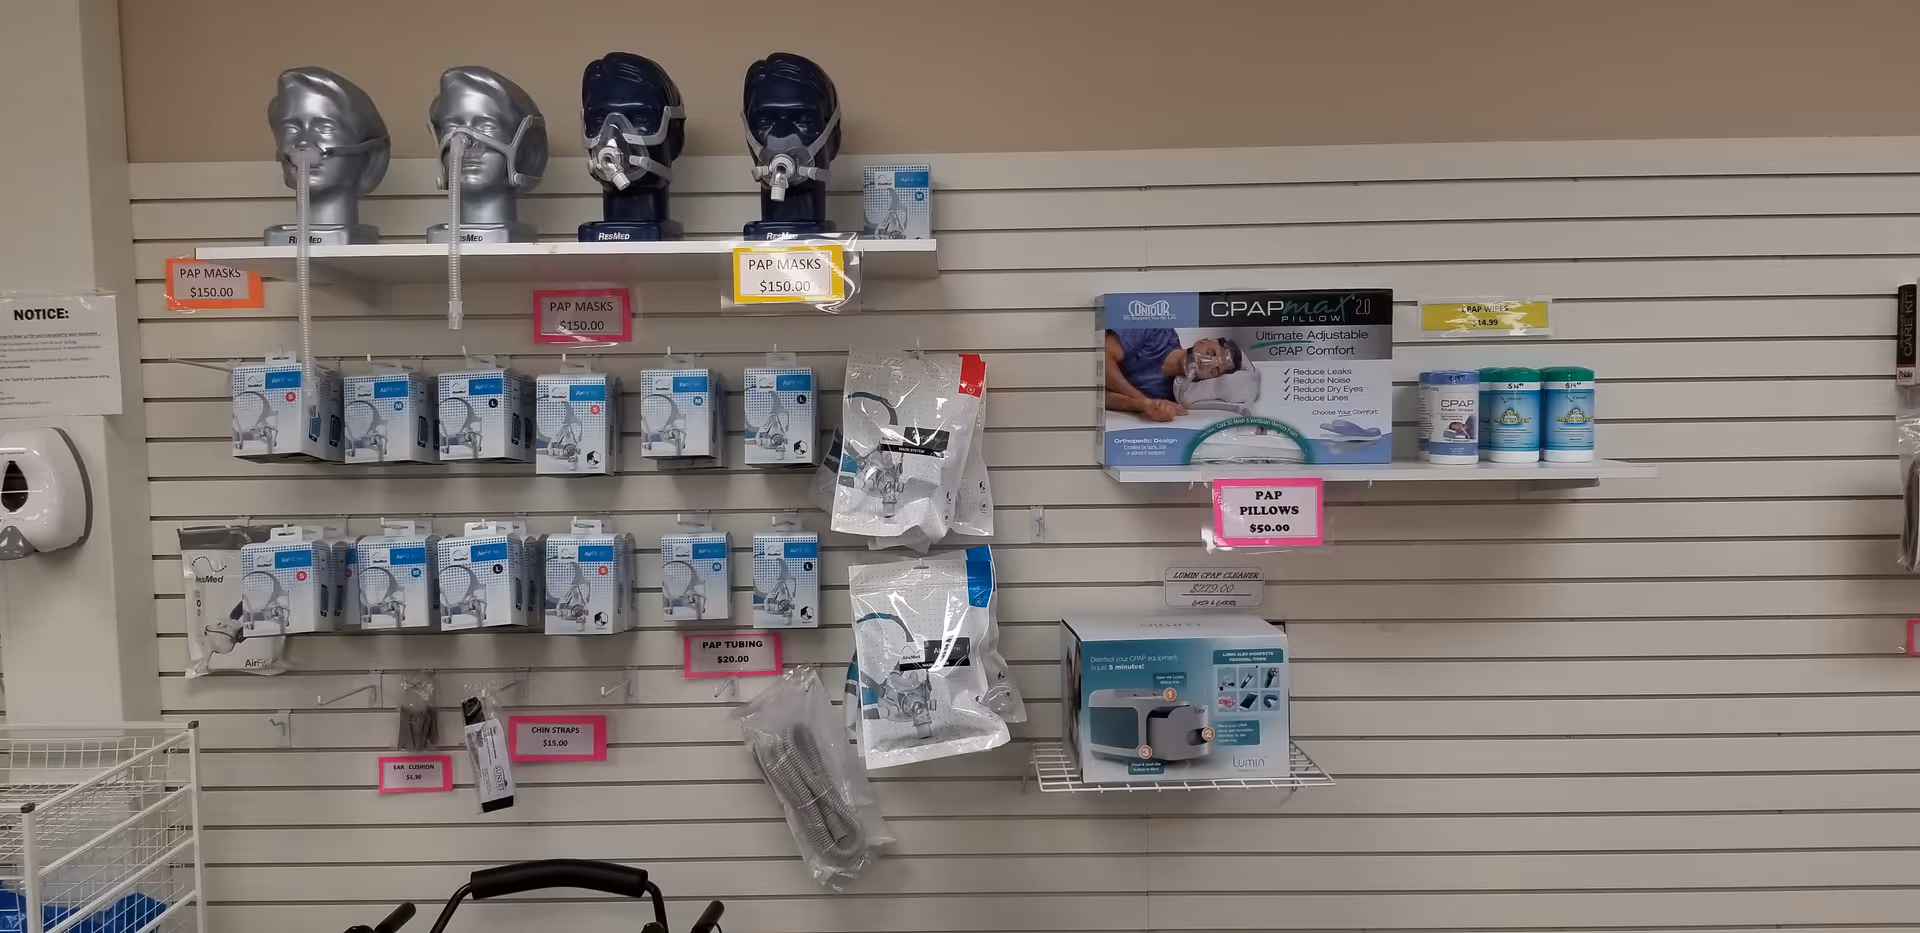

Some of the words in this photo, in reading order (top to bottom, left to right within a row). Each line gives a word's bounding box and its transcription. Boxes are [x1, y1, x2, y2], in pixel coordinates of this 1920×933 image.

[749, 259, 773, 271] PAP
[777, 258, 821, 270] MASKS
[180, 268, 200, 279] PAP
[203, 268, 241, 279] MASKS
[760, 280, 811, 293] $150.00
[190, 286, 234, 299] $150.00
[550, 301, 572, 312] PAP
[575, 301, 614, 312] MASKS
[1211, 300, 1284, 317] CPAP
[1355, 298, 1371, 315] 2.0
[1904, 292, 1914, 314] KIT
[1128, 300, 1170, 317] CONTOUR
[1462, 305, 1482, 313] CPAP
[1484, 304, 1509, 312] WIPES
[14, 307, 70, 321] NOTICE:
[1281, 315, 1341, 323] PILLOW
[559, 320, 604, 332] $150.00
[1472, 318, 1499, 327] $14.99
[1256, 330, 1304, 341] Ultimate
[1306, 329, 1369, 342] Adjustable
[1903, 317, 1913, 357] CARE
[1269, 346, 1303, 356] CPAP
[1306, 345, 1355, 356] Comfort
[1293, 368, 1326, 376] Reduce
[1327, 367, 1352, 375] Leaks
[1899, 370, 1913, 378] Pride
[1327, 376, 1351, 384] Noise
[1293, 385, 1326, 393] Reduce
[1327, 385, 1342, 394] Dry
[1343, 385, 1364, 394] Eyes
[1293, 394, 1326, 402] Reduce
[1327, 394, 1349, 402] Lines
[1440, 399, 1474, 408] CPAP
[1114, 437, 1152, 446] Orthopedic
[1255, 490, 1283, 500] PAP
[1239, 505, 1299, 516] PILLOWS
[1249, 523, 1290, 534] $50.00
[1190, 583, 1235, 594] $279.00
[703, 641, 722, 649] PAP
[726, 640, 763, 649] TUBING
[717, 655, 749, 664] $20.00
[1115, 656, 1128, 664] your
[1147, 654, 1178, 663] equipment
[1167, 690, 1173, 698] 1
[531, 726, 550, 734] CHIN
[551, 726, 580, 734] STRAPS
[1204, 730, 1212, 738] 2
[542, 739, 568, 748] $15.00
[1142, 748, 1149, 756] 3
[1232, 756, 1265, 768] Lumin
